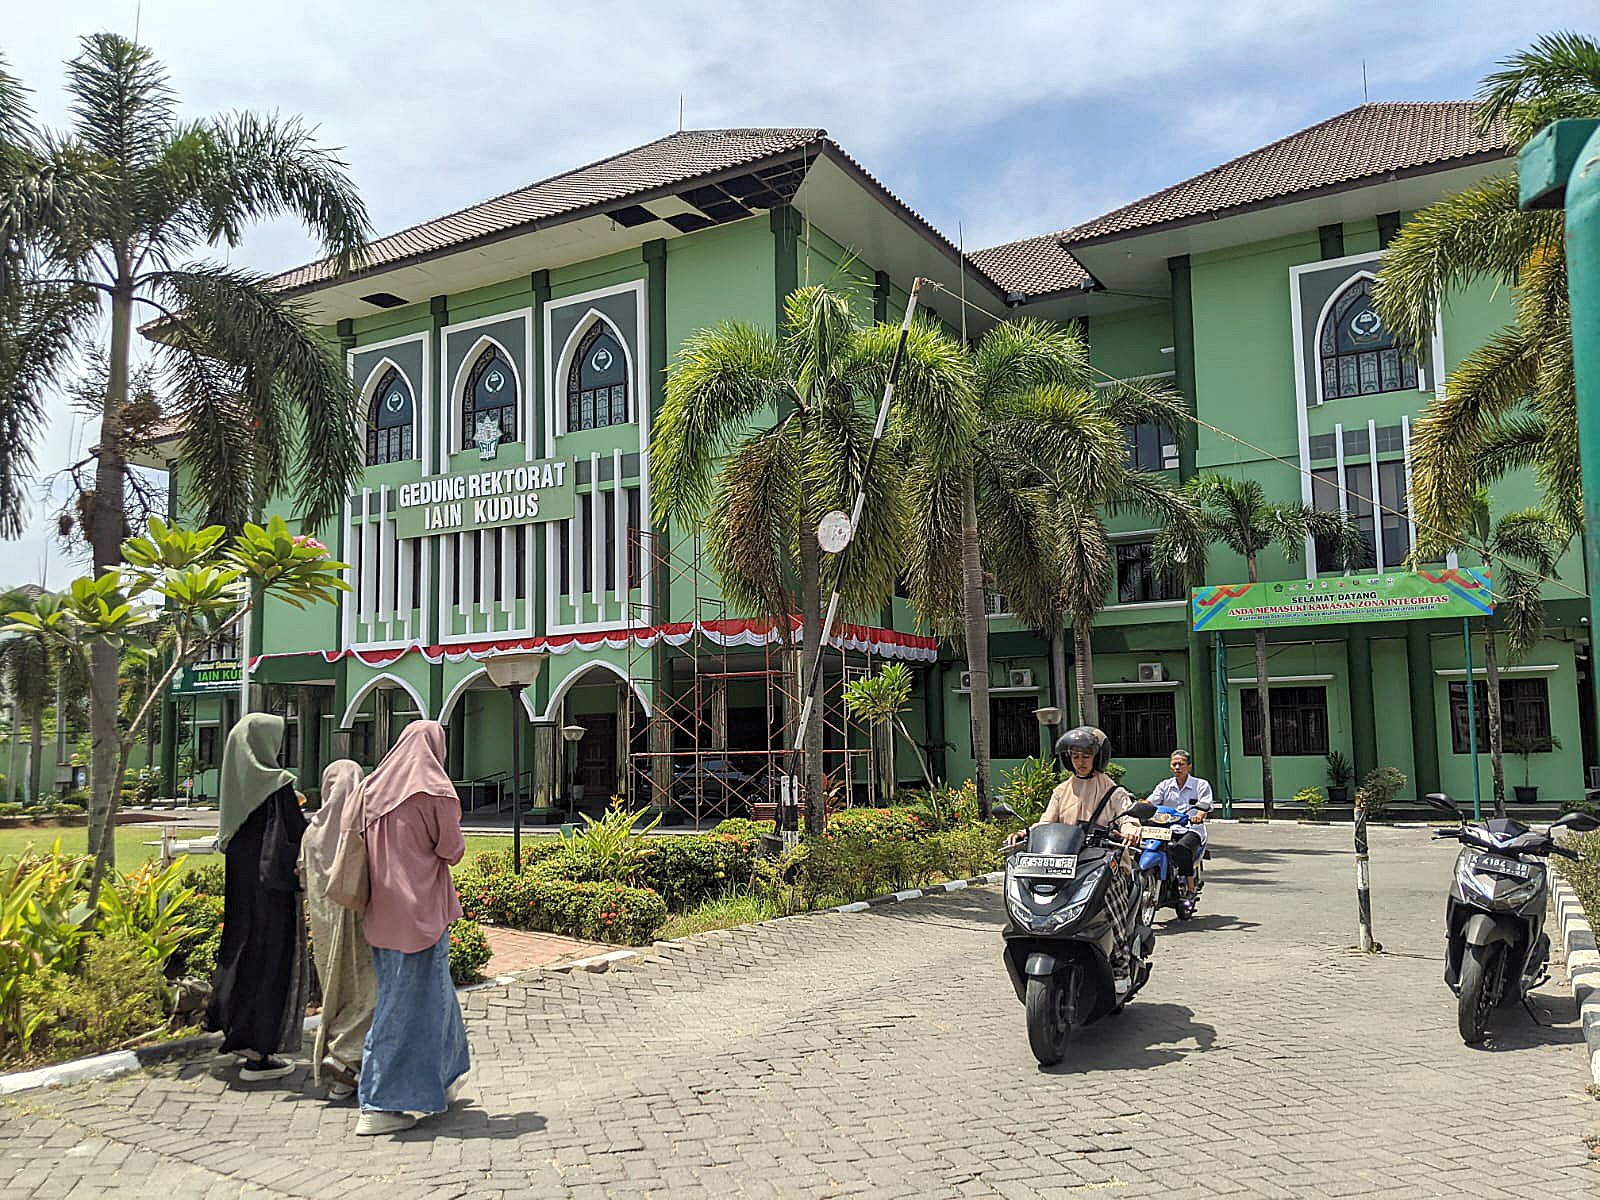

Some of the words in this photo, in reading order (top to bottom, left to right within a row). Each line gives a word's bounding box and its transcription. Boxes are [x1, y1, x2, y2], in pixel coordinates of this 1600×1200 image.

[399, 476, 465, 508] GEDUNG
[468, 462, 566, 498] REKTORAT
[424, 503, 462, 530] IAIN
[474, 493, 539, 524] KUDUS
[1229, 607, 1254, 615] ANDA
[1255, 605, 1306, 614] MEMASUKI
[1308, 601, 1356, 611] KAWASAN
[1358, 599, 1385, 608] ZONA
[1387, 596, 1449, 606] INTEGRITAS
[1291, 594, 1335, 604] SELAMAT
[1338, 591, 1377, 601] DATANG
[198, 671, 219, 681] IAIN
